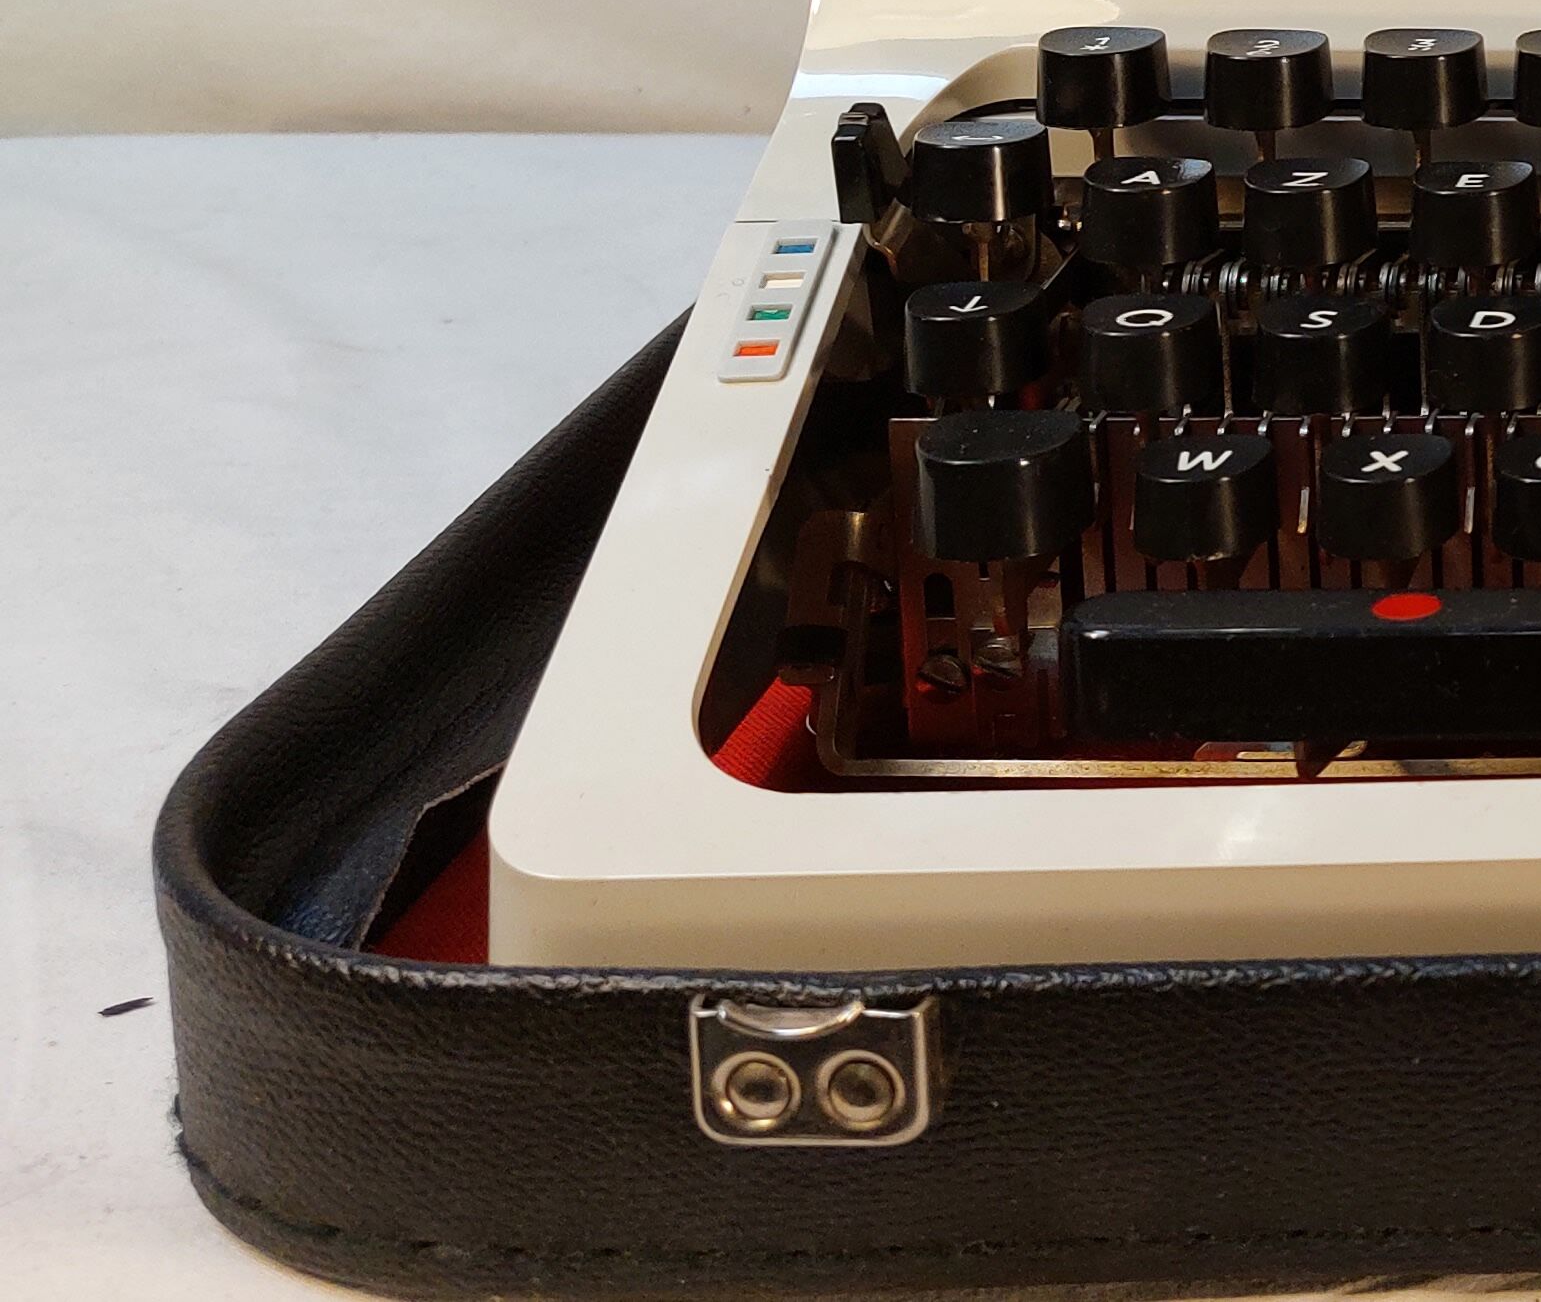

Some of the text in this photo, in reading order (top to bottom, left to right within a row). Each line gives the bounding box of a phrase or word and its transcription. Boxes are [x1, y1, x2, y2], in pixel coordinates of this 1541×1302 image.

[1120, 170, 1161, 186] A
[1282, 171, 1329, 187] Z
[1455, 173, 1490, 188] E
[1115, 308, 1174, 328] Q
[1300, 310, 1338, 329] S
[1469, 310, 1516, 329] D
[1177, 450, 1233, 471] W
[1361, 450, 1409, 472] X
